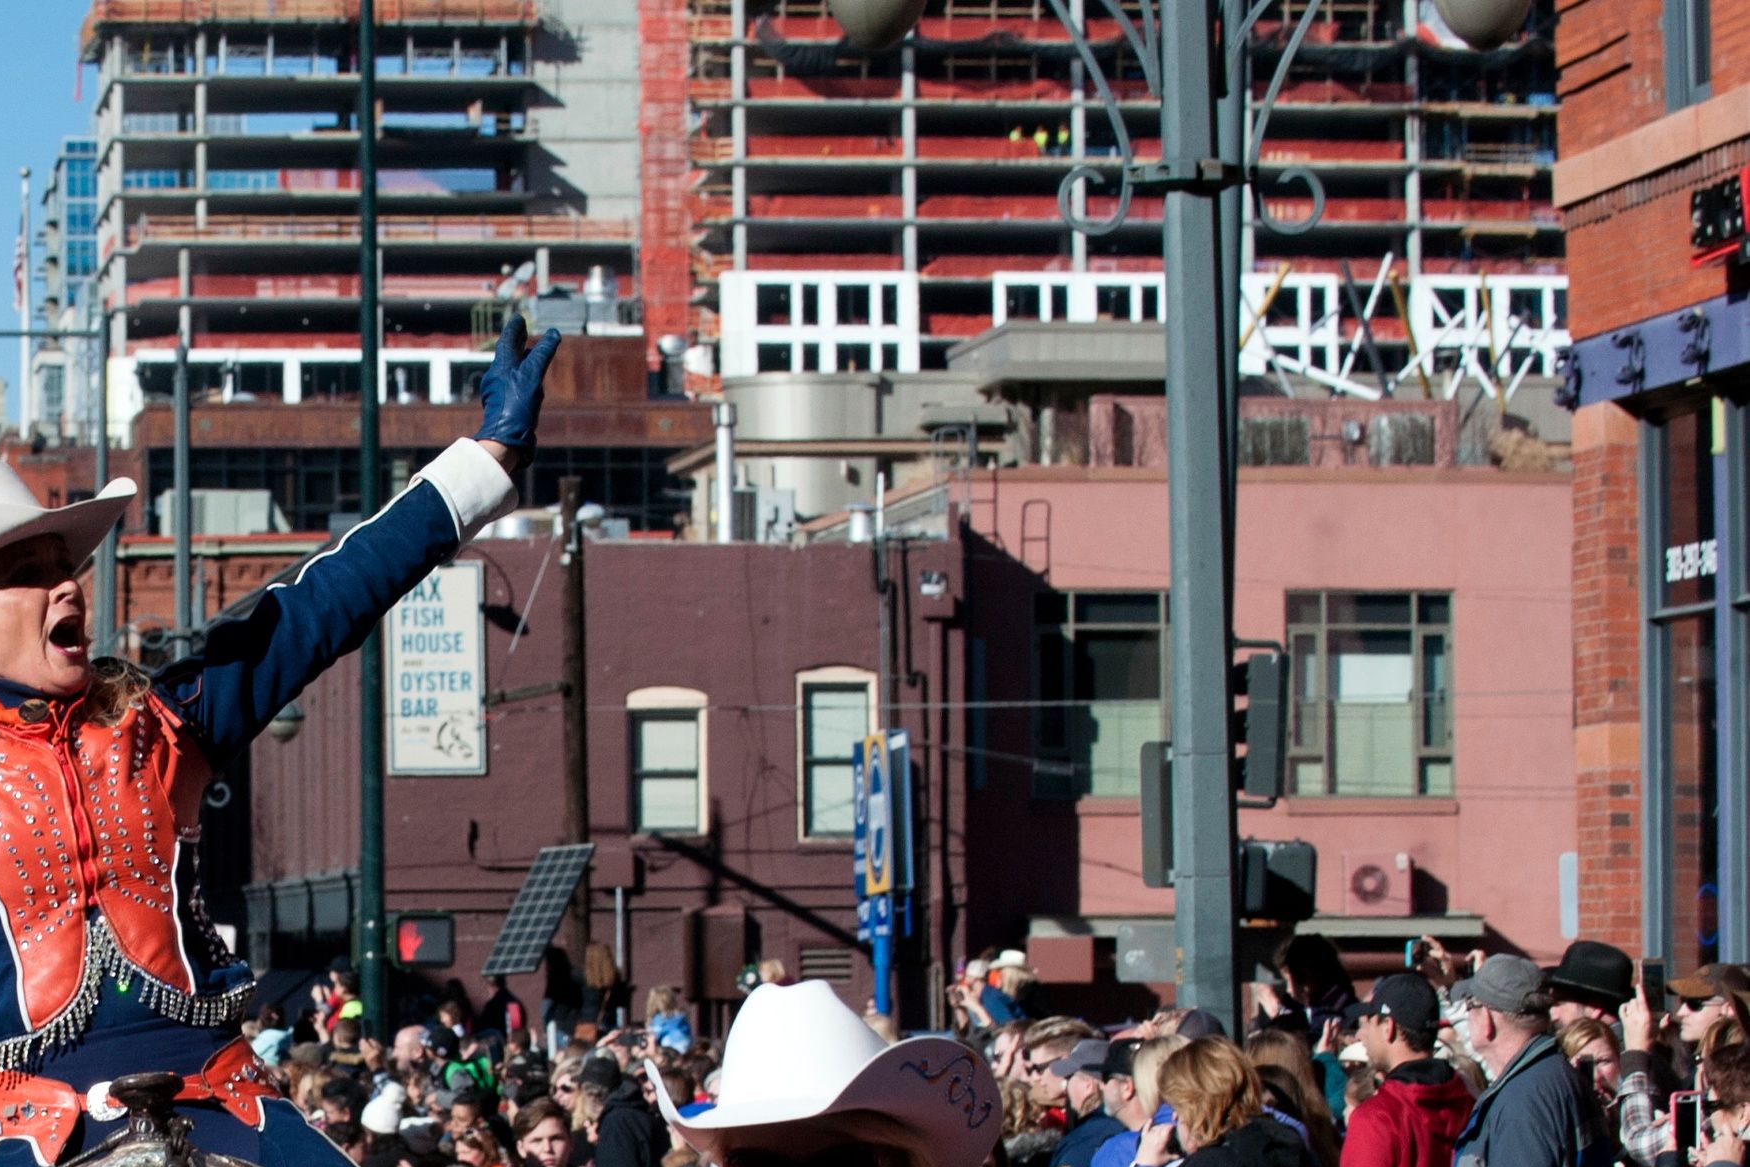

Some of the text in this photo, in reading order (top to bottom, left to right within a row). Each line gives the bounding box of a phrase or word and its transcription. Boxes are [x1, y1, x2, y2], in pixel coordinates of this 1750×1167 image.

[401, 607, 445, 627] FISH
[401, 632, 464, 653] HOUSE
[400, 671, 473, 692] OYSTER
[400, 698, 438, 718] BAR
